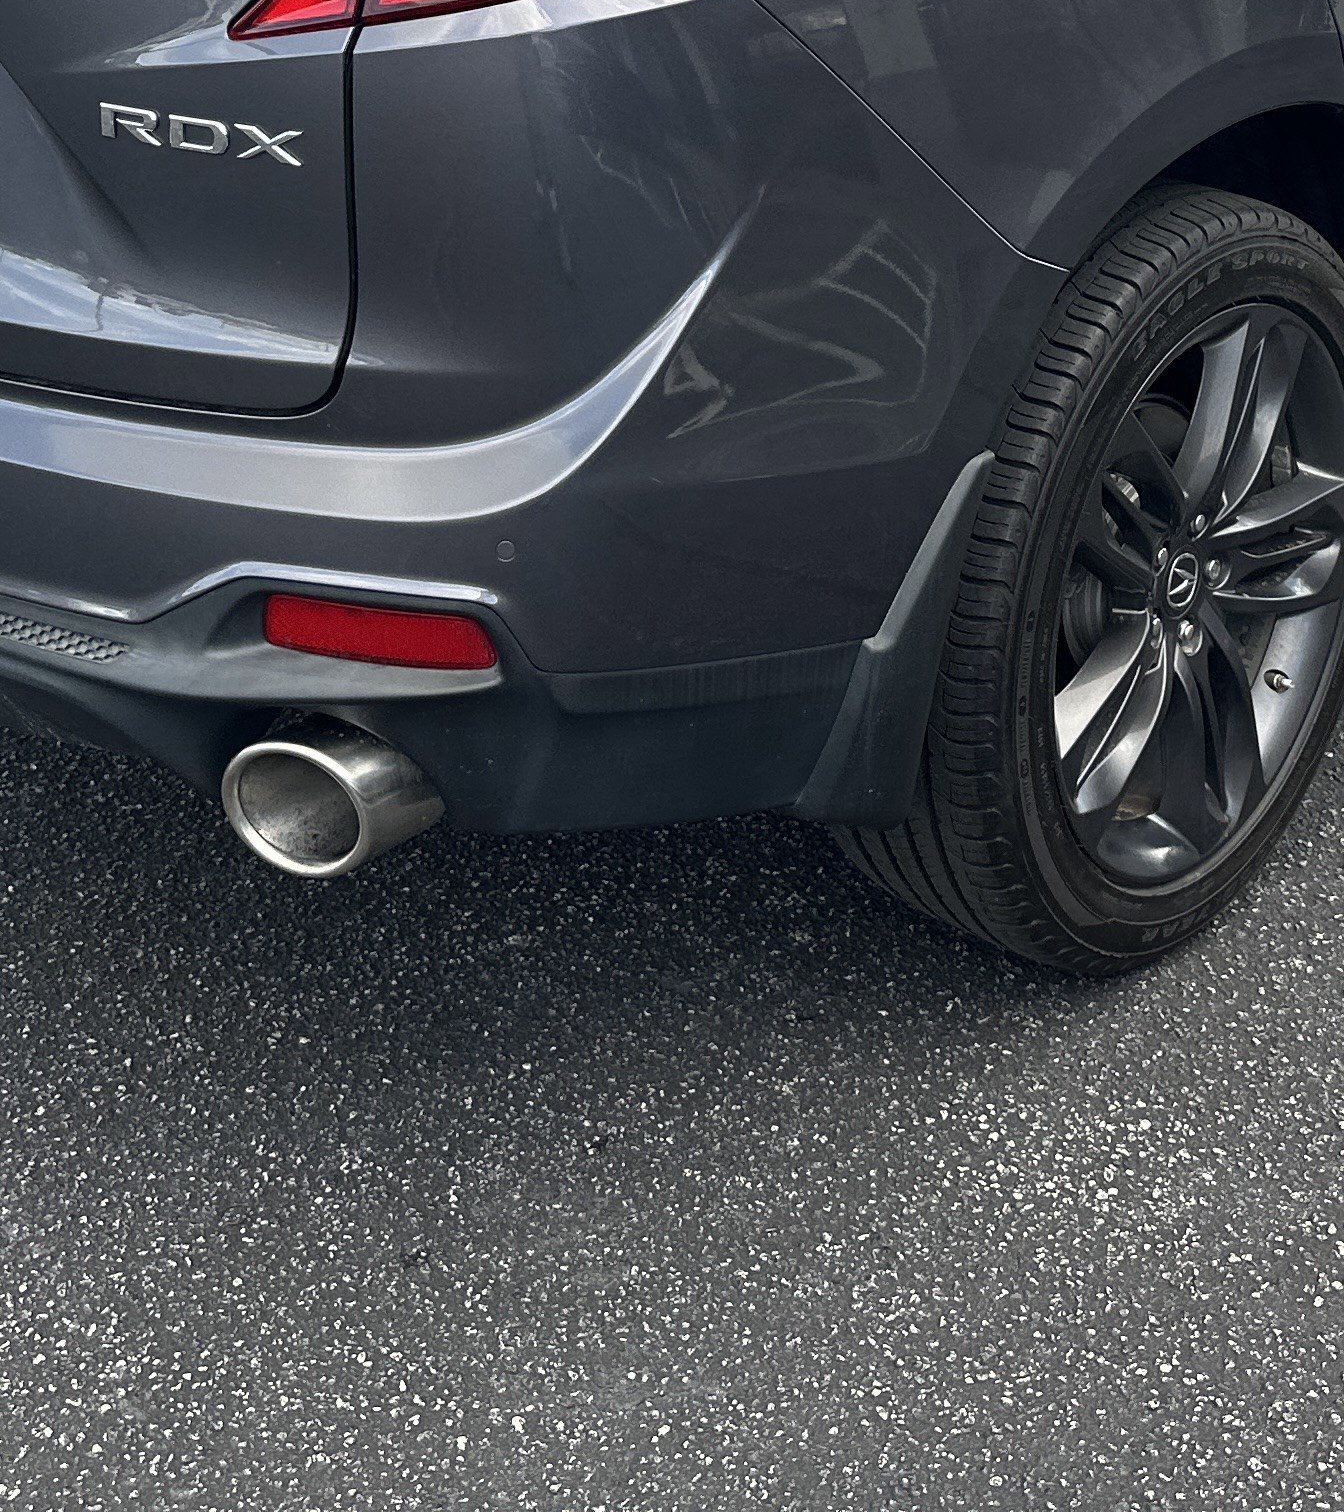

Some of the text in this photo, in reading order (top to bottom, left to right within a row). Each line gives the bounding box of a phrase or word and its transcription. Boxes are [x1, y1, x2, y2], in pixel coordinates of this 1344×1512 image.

[99, 102, 305, 167] RDX
[1132, 261, 1224, 362] EAGLE
[1229, 250, 1310, 271] SPORT
